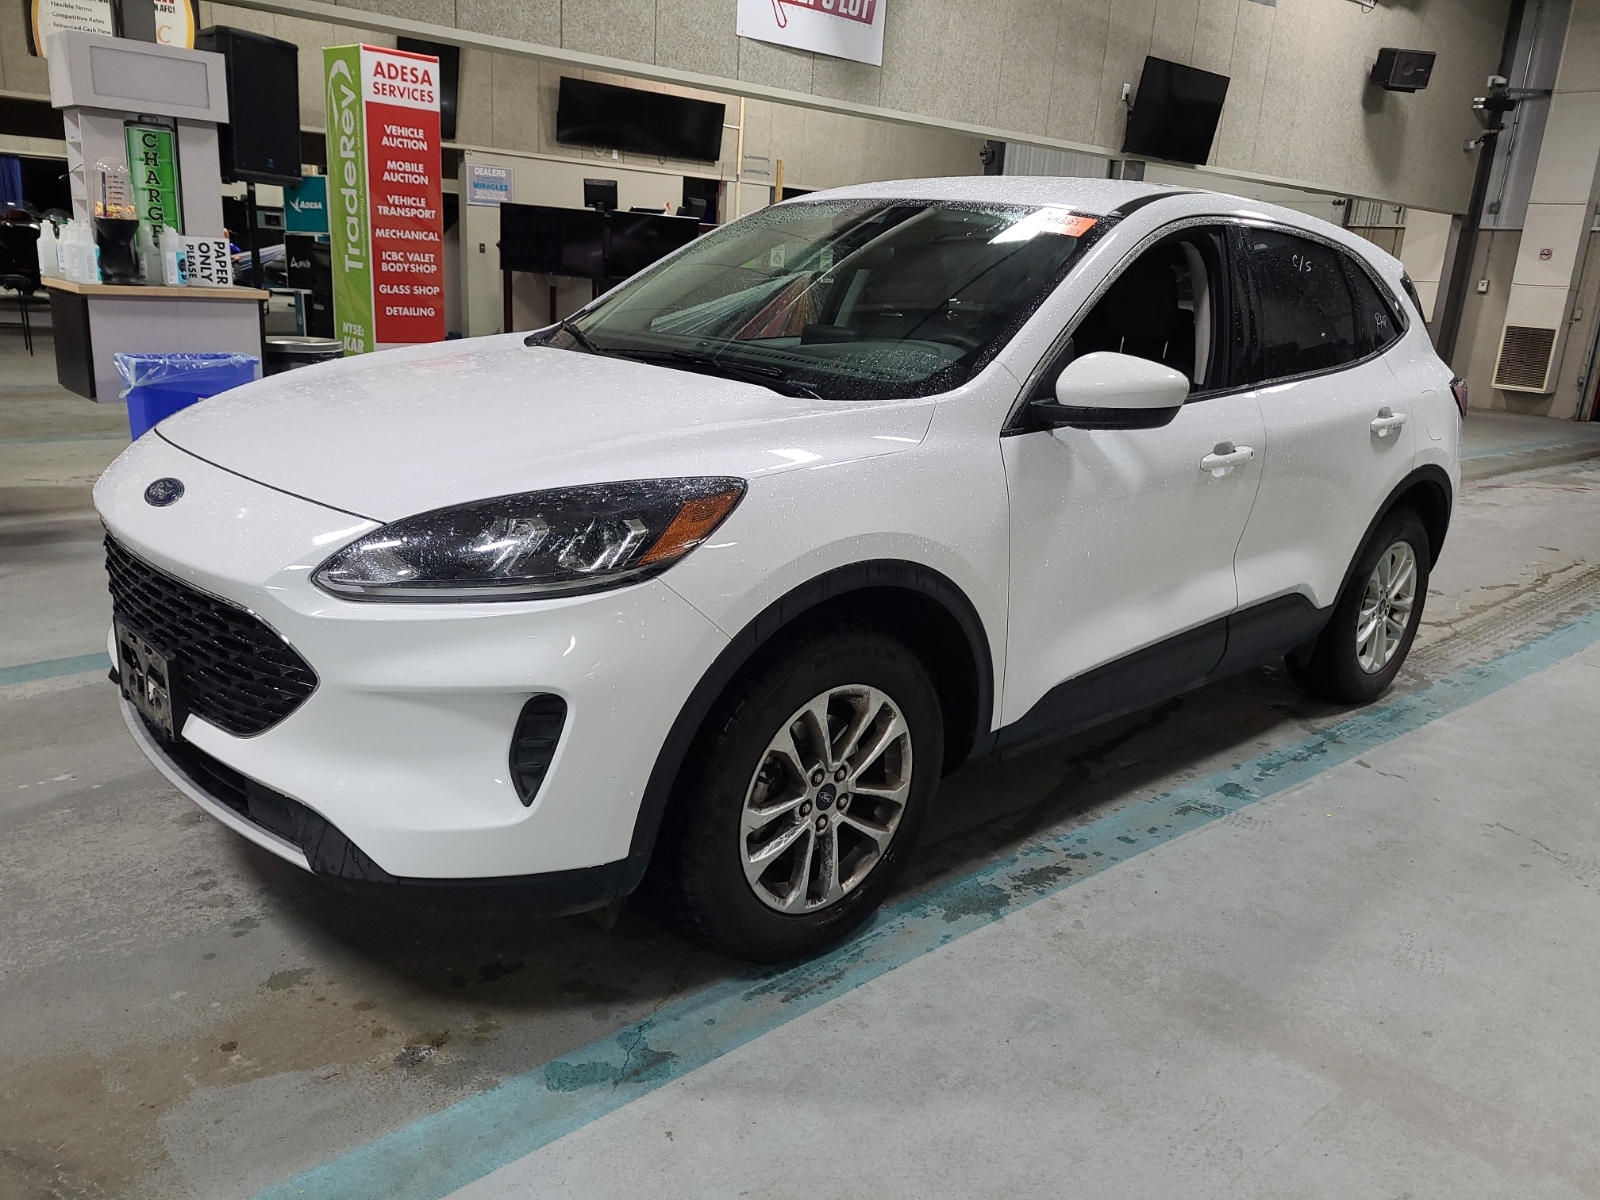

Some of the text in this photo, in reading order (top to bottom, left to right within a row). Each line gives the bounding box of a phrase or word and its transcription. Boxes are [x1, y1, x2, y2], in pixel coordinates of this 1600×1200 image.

[50, 1, 75, 10] Flexible
[51, 11, 88, 22] Competitive
[53, 21, 82, 31] Enhanced
[372, 60, 433, 87] ADESA
[373, 81, 434, 103] SERVICES
[384, 124, 425, 140] VEHICLE
[381, 135, 428, 151] AUCTION
[387, 160, 424, 174] MOBILE
[474, 167, 507, 178] DEALERS
[339, 83, 364, 273] TradeRev
[382, 171, 429, 186] AUCTION
[472, 181, 509, 192] MIRACLES
[386, 194, 427, 208] VEHICLE
[377, 205, 436, 220] TRANSPORT
[375, 227, 440, 242] MECHANICAL
[185, 244, 198, 279] PLEASE
[198, 242, 213, 283] ONLY
[213, 241, 229, 285] PAPER
[382, 251, 435, 263] ICBC VALET
[379, 284, 440, 296] GLASS SHOP
[385, 306, 436, 317] DETAILING
[342, 321, 365, 337] NYSE:
[343, 335, 365, 354] KAR
